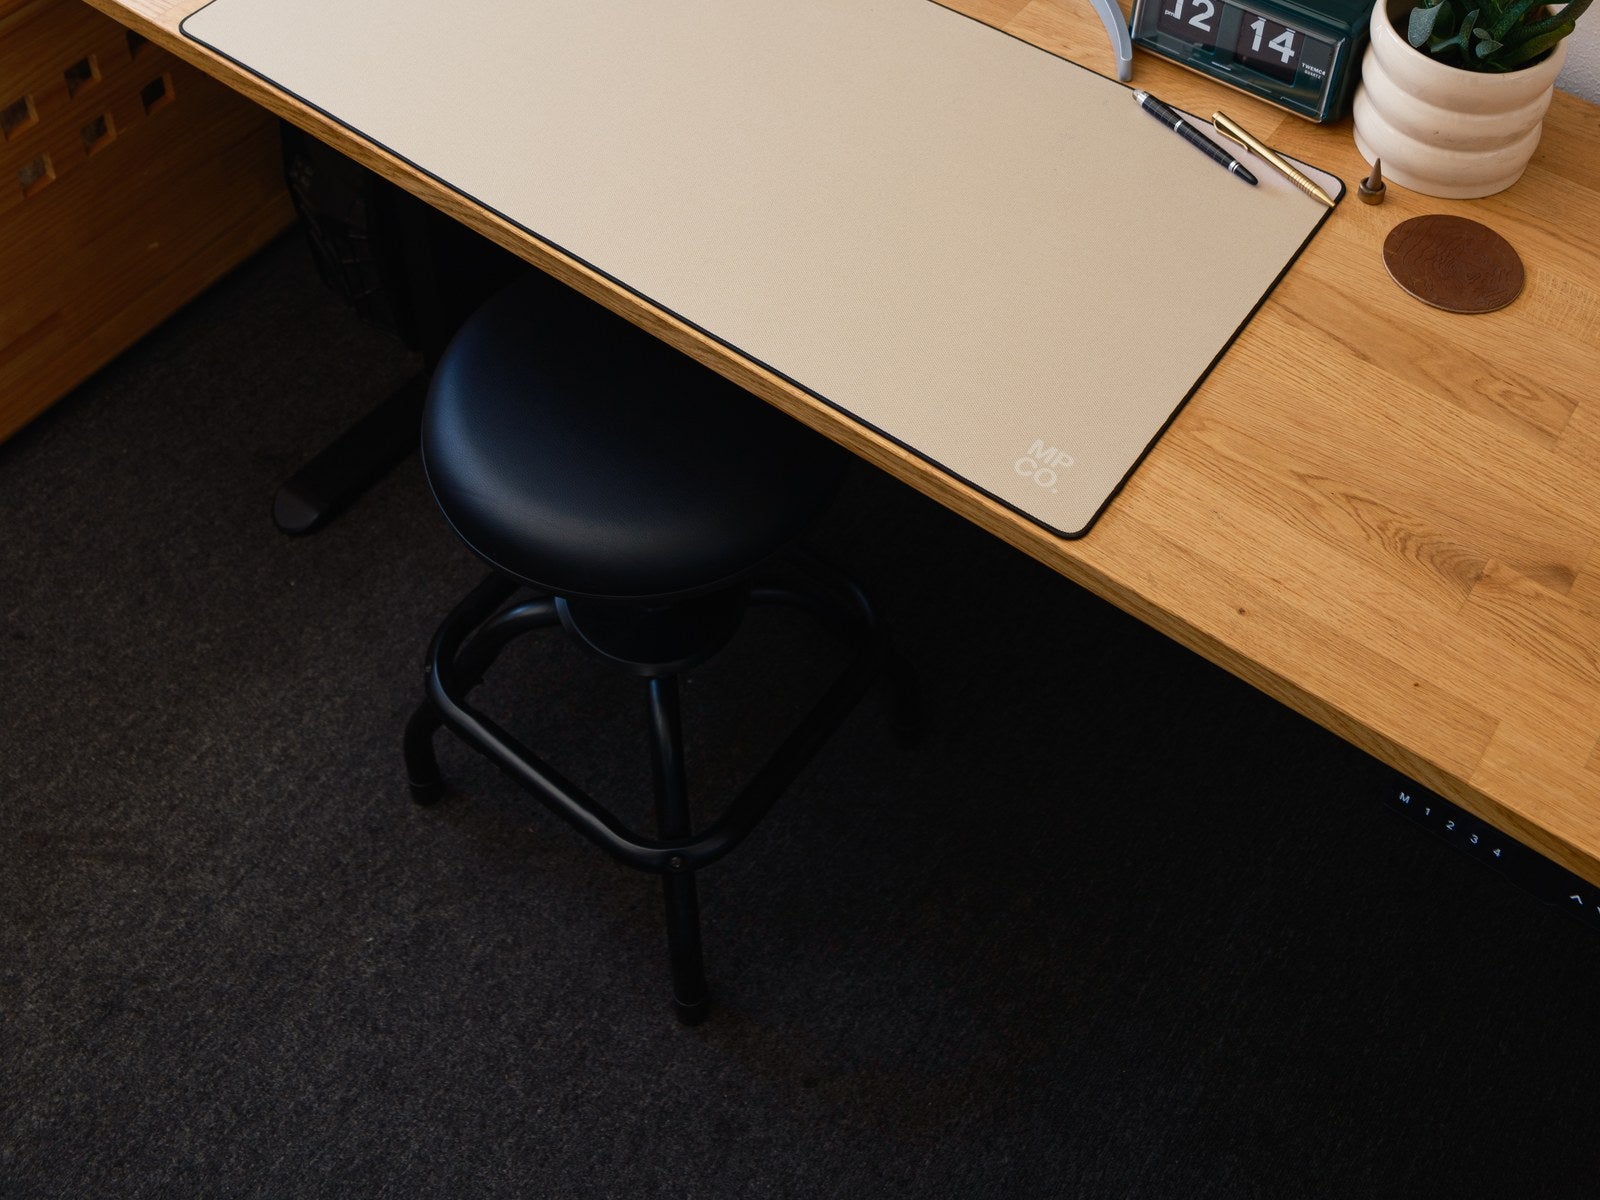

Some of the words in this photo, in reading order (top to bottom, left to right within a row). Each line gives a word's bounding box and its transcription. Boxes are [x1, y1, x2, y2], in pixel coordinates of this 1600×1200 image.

[1249, 18, 1295, 64] 14
[1013, 455, 1057, 494] CO.
[1027, 439, 1075, 469] MP
[1399, 791, 1411, 804] M
[1425, 807, 1431, 816] 1
[1446, 820, 1455, 831] 2
[1470, 833, 1479, 844] 3
[1493, 848, 1501, 857] 4
